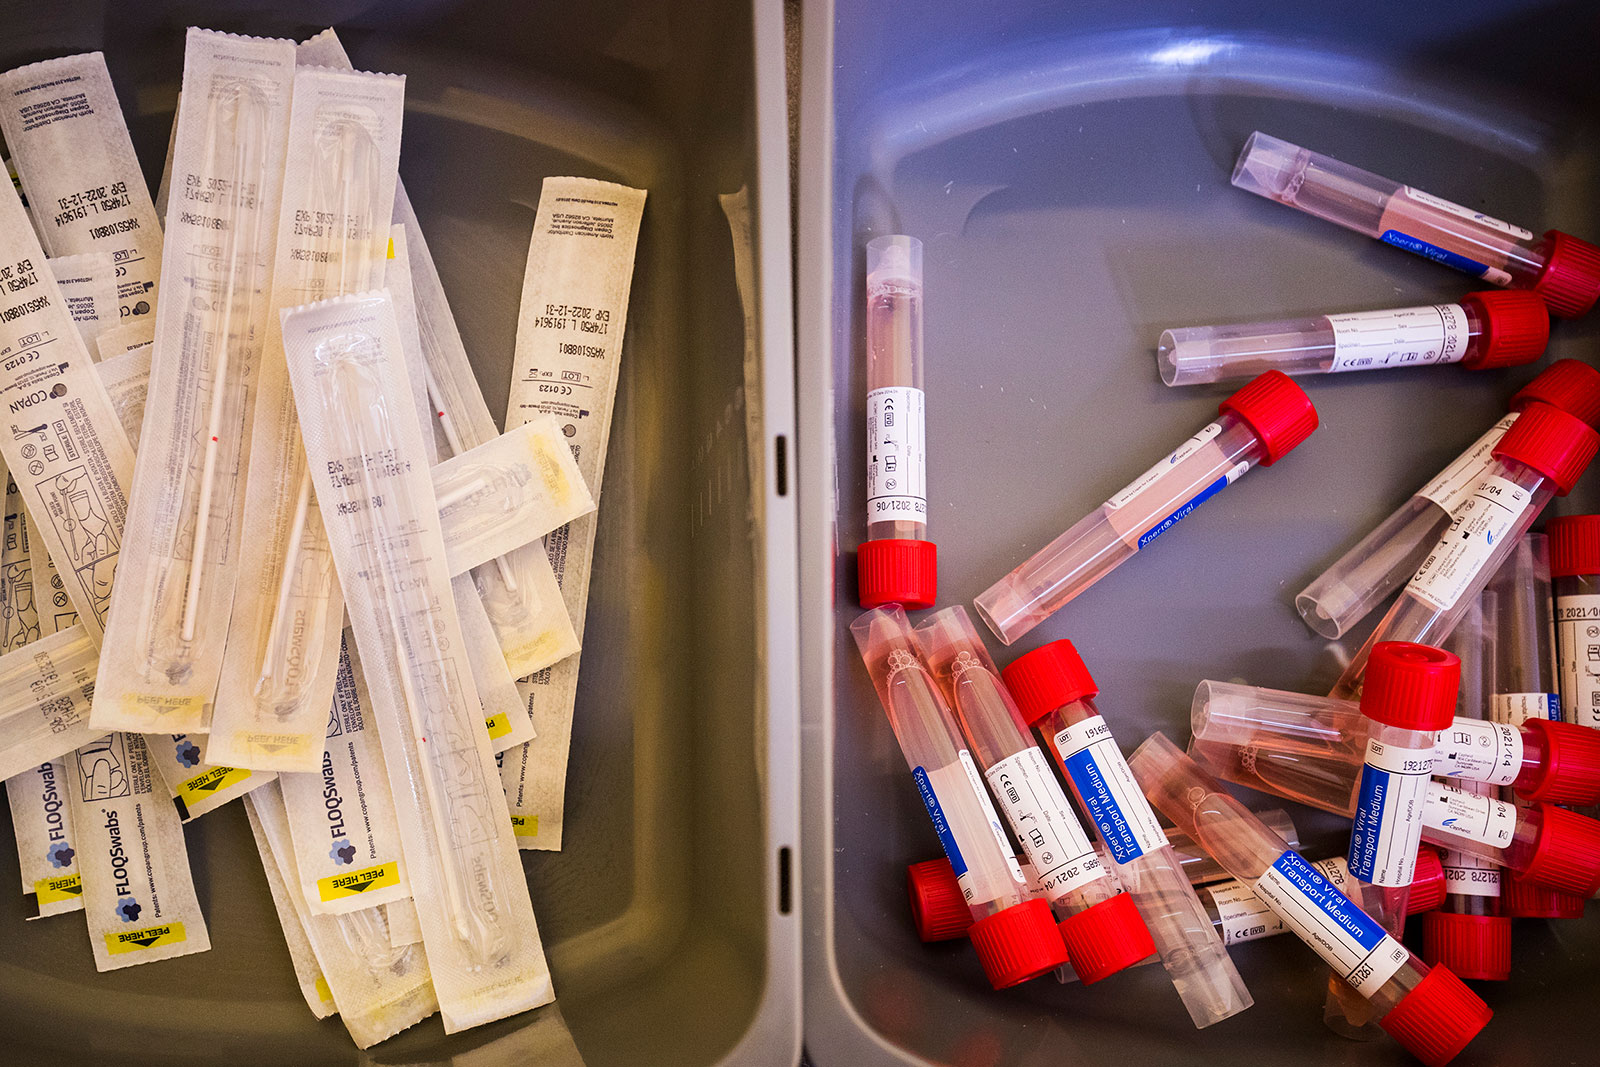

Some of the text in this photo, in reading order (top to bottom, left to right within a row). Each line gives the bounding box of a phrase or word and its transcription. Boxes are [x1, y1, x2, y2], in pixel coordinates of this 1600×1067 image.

[18, 105, 32, 114] USA
[34, 103, 89, 121] Copan Diagnostics
[78, 108, 94, 116] North
[100, 192, 131, 212] 174R50
[560, 222, 612, 233] Copan Diagnostics
[572, 218, 596, 227] Jefferson
[1423, 245, 1449, 261] Viral
[5, 271, 39, 293] 174R50
[579, 320, 608, 334] 174R50
[19, 333, 38, 345] LOT
[3, 355, 27, 372] 0123
[561, 372, 578, 380] LOT
[537, 383, 558, 393] 0123
[8, 389, 49, 414] COPAN
[884, 398, 893, 410] CE
[61, 433, 75, 458] STERILE
[875, 500, 910, 511] 2021/06
[1172, 502, 1195, 521] Viral
[1450, 497, 1469, 516] Specimen
[343, 713, 352, 733] STERILE
[1058, 733, 1070, 743] LOT
[1499, 726, 1514, 767] 2021/04
[1371, 745, 1382, 753] LOT
[186, 774, 210, 791] HERE
[998, 772, 1019, 802] CE IVD
[1013, 756, 1052, 823] Specimen Date
[347, 740, 376, 859] Patents: www.copangroup.com/patents
[1082, 761, 1140, 855] Transport Medium
[1058, 809, 1067, 821] Sex
[1086, 795, 1105, 822] Viral
[930, 807, 947, 834] Viral
[1354, 807, 1369, 831] Viral
[1356, 783, 1387, 877] Transport Medium
[1140, 833, 1151, 849] Name
[134, 802, 161, 917] Patents: www.copangroup.com/patents
[48, 877, 76, 890] HERE
[331, 868, 384, 888] PEEL HERE
[1042, 865, 1080, 891] 2021/04
[1266, 871, 1281, 885] Name
[1377, 869, 1387, 883] Name
[1276, 858, 1366, 938] Transport Medium
[1321, 883, 1347, 907] Viral
[1222, 911, 1247, 921] Specimen
[1255, 882, 1275, 900] Hospital
[1310, 931, 1334, 952] Age/DOB
[118, 926, 170, 942] PEEL HERE
[1392, 950, 1403, 961] LOT
